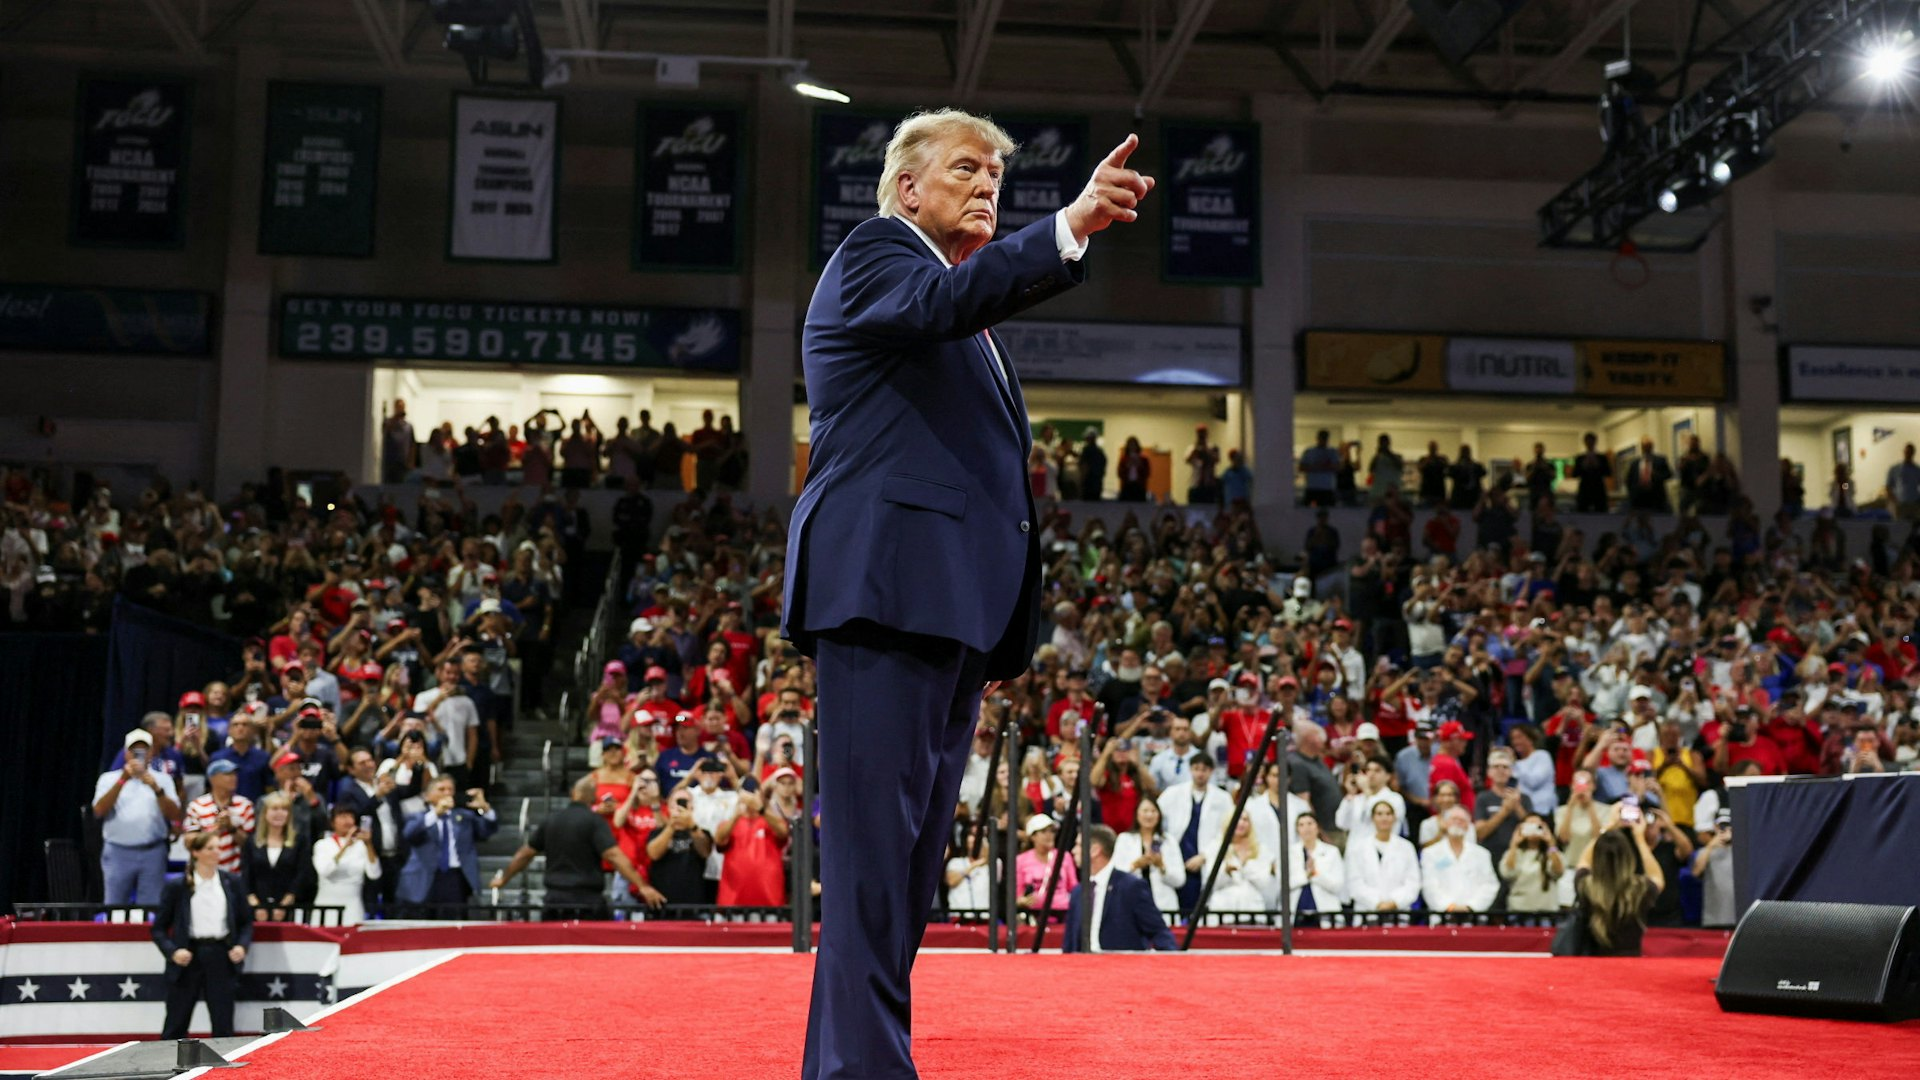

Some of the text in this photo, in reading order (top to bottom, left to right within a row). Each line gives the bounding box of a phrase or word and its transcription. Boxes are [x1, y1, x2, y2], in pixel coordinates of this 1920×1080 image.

[470, 120, 543, 138] ASUN
[666, 174, 712, 193] NCAA
[839, 183, 877, 204] NCA
[646, 191, 732, 209] TOURNAMENT
[1187, 195, 1235, 215] NCAA
[286, 300, 649, 327] GET YOUR FGCU TICKETS NOW!
[297, 321, 637, 362] 239.590.7145
